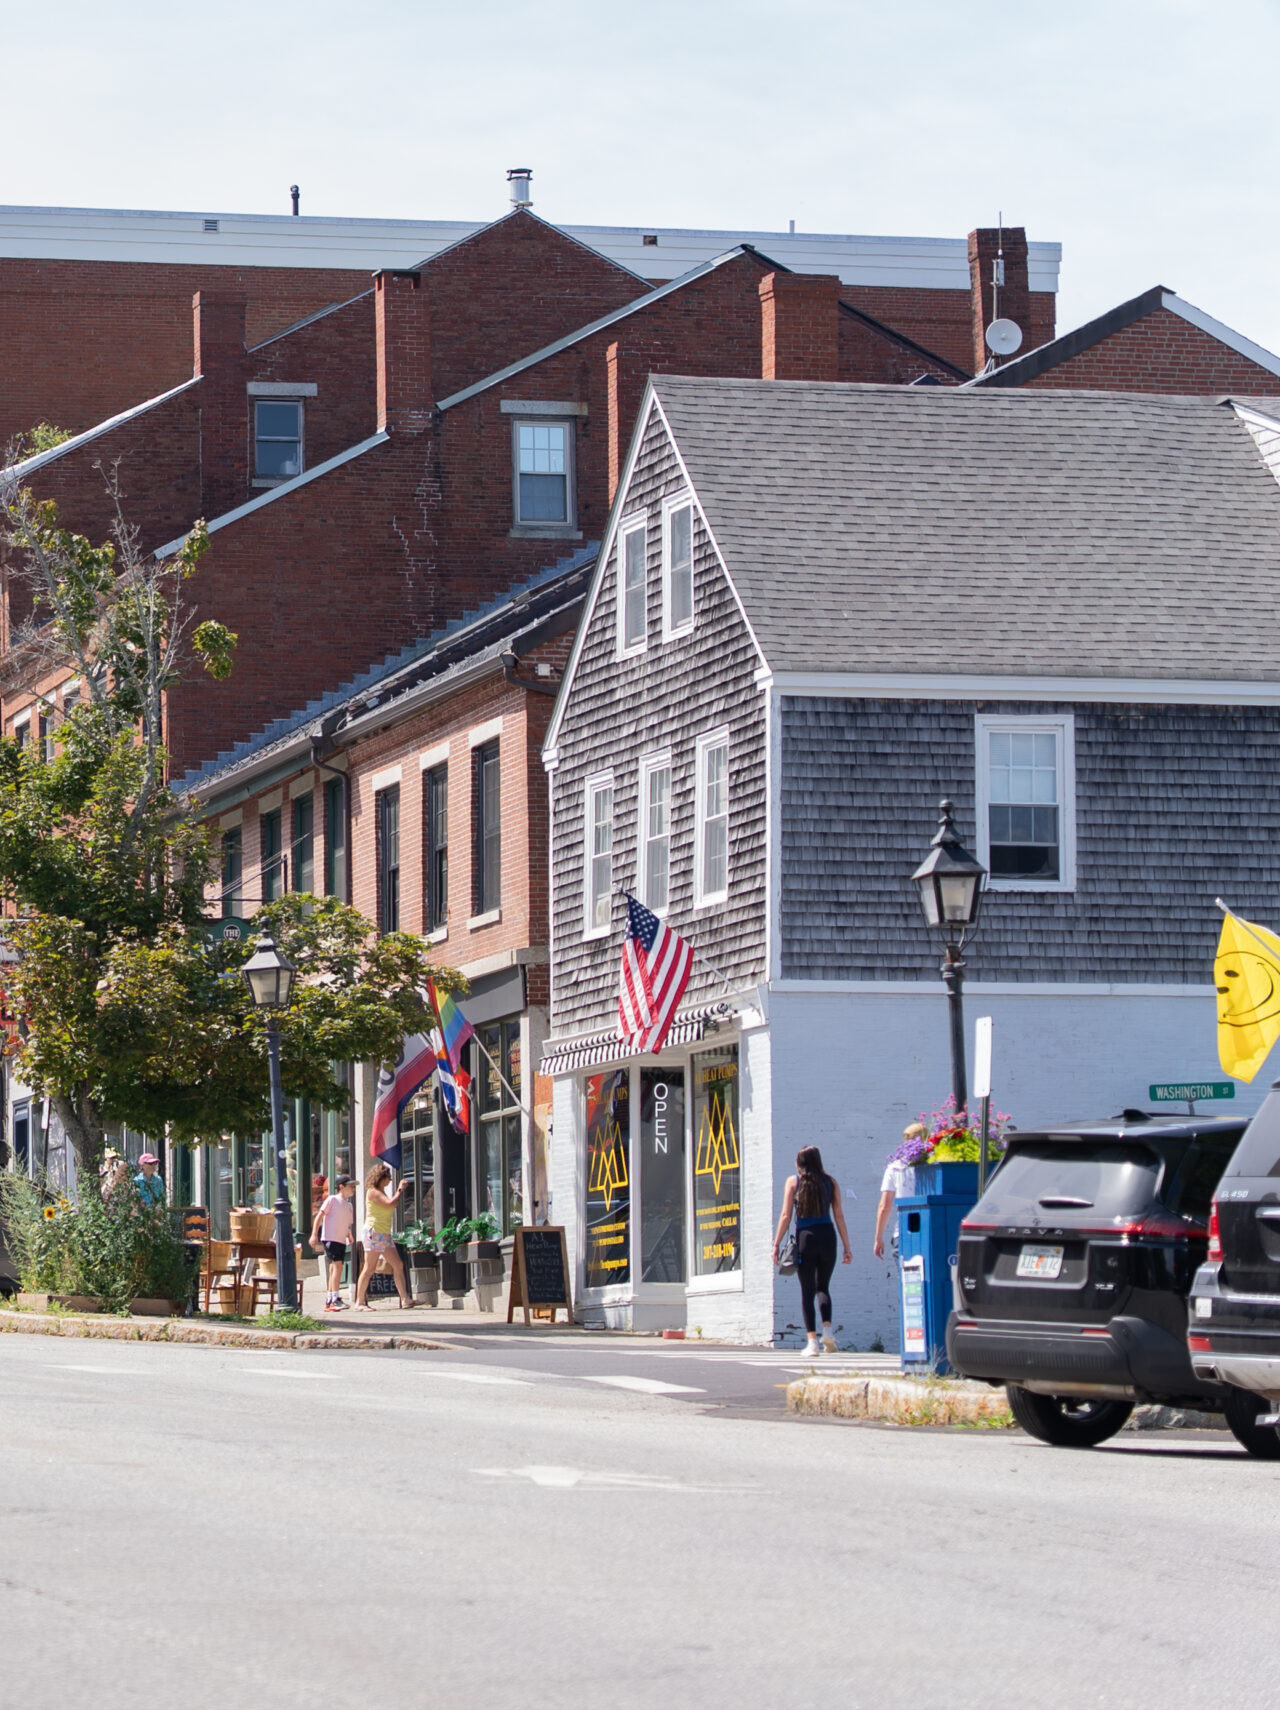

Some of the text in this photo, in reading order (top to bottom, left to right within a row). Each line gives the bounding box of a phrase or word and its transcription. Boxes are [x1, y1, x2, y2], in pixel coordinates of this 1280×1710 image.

[226, 929, 240, 937] THE
[1156, 1085, 1214, 1099] WASHINGTON
[653, 1083, 668, 1154] OPEN
[1231, 1190, 1249, 1198] 450
[370, 1280, 395, 1292] FREE
